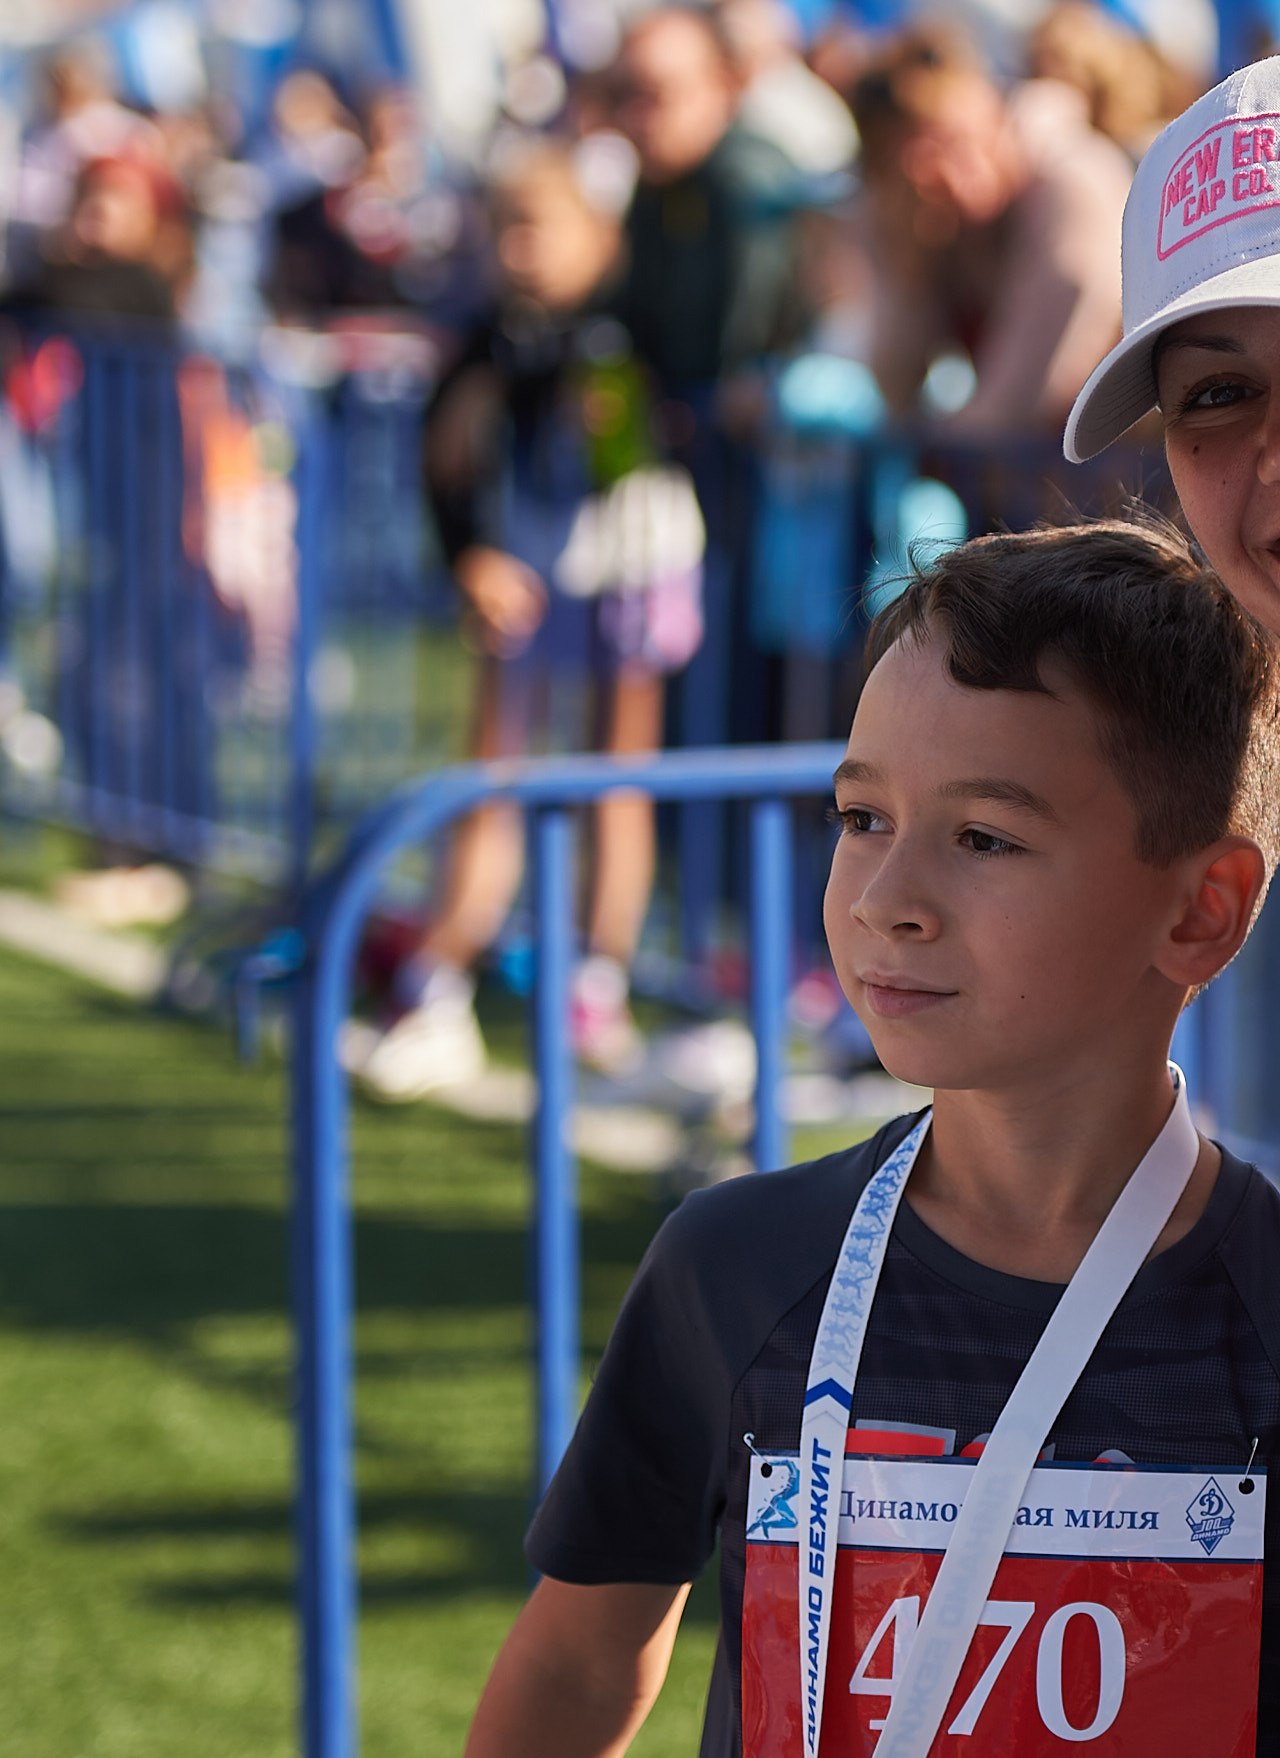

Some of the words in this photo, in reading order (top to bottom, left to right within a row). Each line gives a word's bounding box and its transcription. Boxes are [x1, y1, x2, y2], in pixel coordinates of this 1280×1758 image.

[1165, 137, 1221, 217] NEW
[1183, 179, 1226, 227] CAP
[1232, 166, 1274, 201] CO.
[809, 1437, 831, 1578] БЕЖИТ
[1064, 1508, 1159, 1530] миля
[808, 1585, 823, 1754] ДИНАМО
[849, 1595, 1126, 1743] 470
